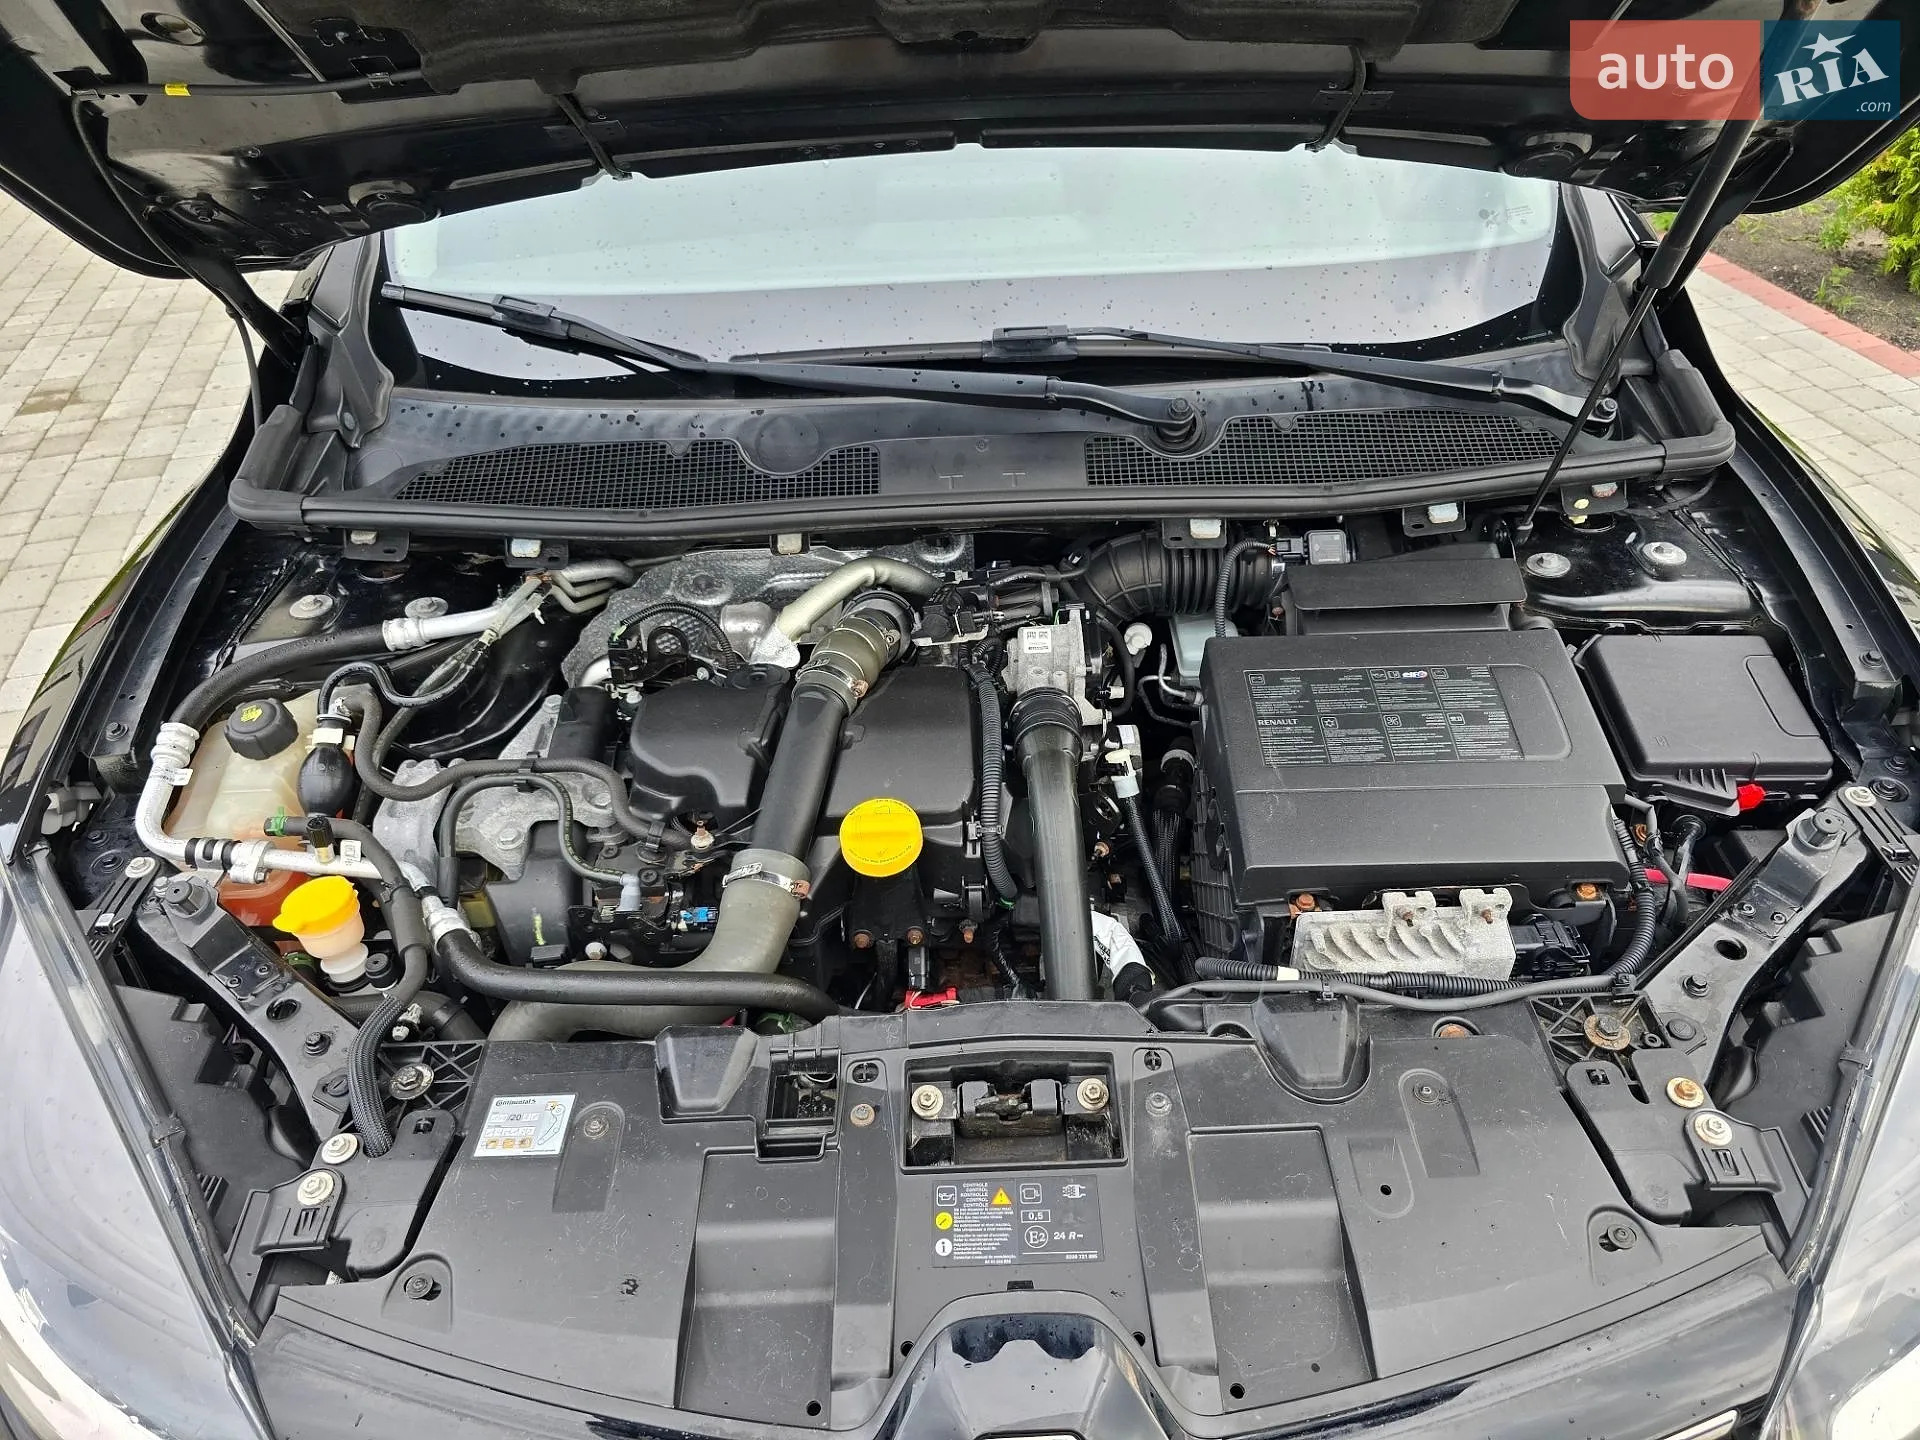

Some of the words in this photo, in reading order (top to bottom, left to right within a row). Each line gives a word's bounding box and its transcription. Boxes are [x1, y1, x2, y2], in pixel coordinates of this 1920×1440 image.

[1257, 718, 1298, 726] RENAULT
[1028, 1211, 1044, 1221] 0,5
[1029, 1231, 1046, 1244] E2
[1053, 1231, 1066, 1240] 24
